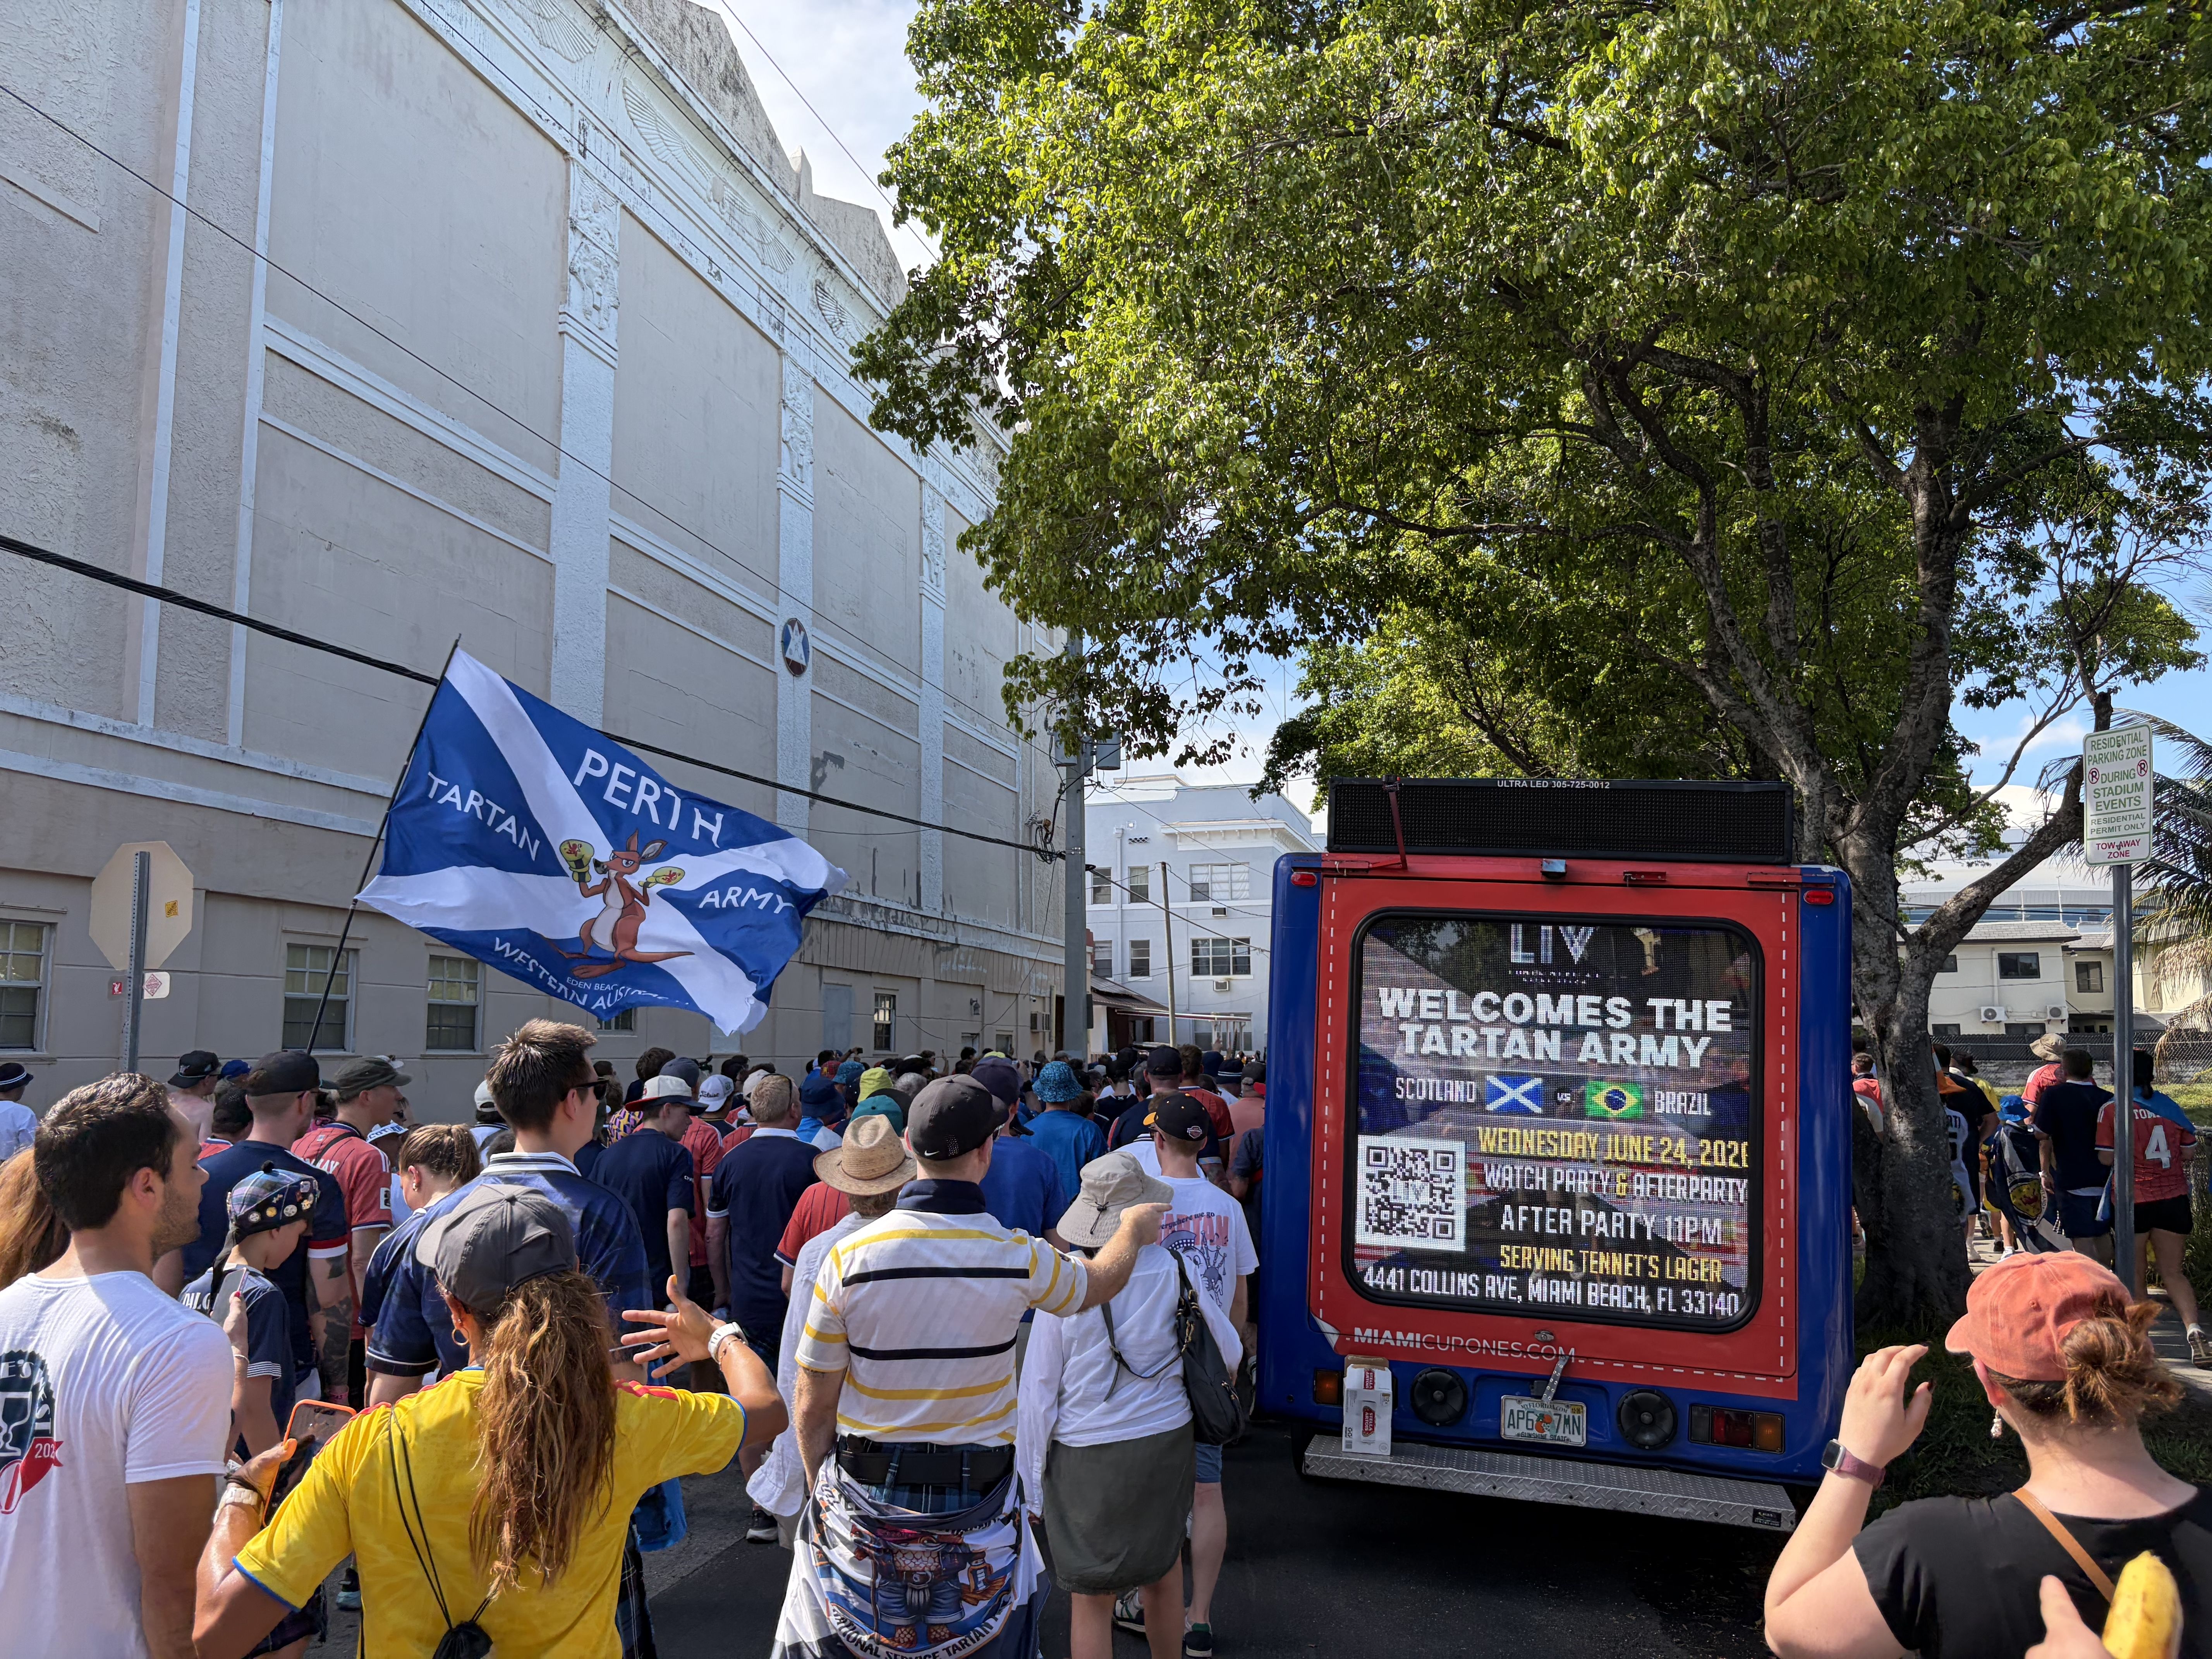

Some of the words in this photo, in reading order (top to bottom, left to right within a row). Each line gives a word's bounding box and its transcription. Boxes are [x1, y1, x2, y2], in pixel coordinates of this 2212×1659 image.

[2088, 749, 2124, 766] PARKING
[2126, 744, 2147, 760] ZONE
[2091, 731, 2143, 751] RESIDENTIAL
[1551, 780, 1610, 789] 305-725-0012
[2093, 781, 2143, 799] STADIUM
[2101, 768, 2136, 784] DURING
[573, 748, 725, 848] PERTH
[2096, 795, 2141, 811] EVENTS
[428, 771, 541, 862] TARTAN
[2090, 825, 2122, 835] PERMIT
[2124, 822, 2146, 831] ONLY
[2091, 812, 2145, 826] RESIDENTIAL
[2107, 850, 2130, 859] ZONE
[698, 885, 796, 914] ARMY
[1511, 923, 1597, 964] LIV
[567, 977, 592, 989] EDEN
[1379, 987, 1632, 1030] WELCOMES
[1647, 998, 1733, 1032] THE
[1398, 1022, 1561, 1062] TARTAN
[1577, 1032, 1711, 1068] ARMY
[1396, 1077, 1477, 1103] SCOTLAND
[1654, 1091, 1712, 1116] BRAZIL
[1477, 1126, 1600, 1159] WEDNESDAY
[1604, 1135, 1653, 1163] JUNE
[1659, 1139, 1692, 1169] 24,
[2145, 1125, 2171, 1169] 4
[1483, 1161, 1546, 1192] WATCH
[1553, 1166, 1611, 1195] PARTY
[1616, 1172, 1628, 1197] &
[1634, 1172, 1748, 1203] AFTERPARTY
[1500, 1204, 1573, 1235] AFTER
[1581, 1209, 1656, 1241] PARTY
[1665, 1213, 1723, 1245] 11PM
[1500, 1244, 1575, 1273] SERVING
[1579, 1249, 1659, 1278] TENNET'S
[1666, 1255, 1722, 1283] LAGER
[1364, 1266, 1405, 1291] 4441
[1410, 1269, 1480, 1297] COLLINS
[1485, 1274, 1522, 1304] AVE,
[1528, 1277, 1582, 1307] MIAMI
[1587, 1281, 1652, 1314] BEACH,
[1657, 1286, 1677, 1313] FL
[1681, 1289, 1740, 1317] 33140
[1354, 1327, 1575, 1363] MIAMICUPONES.COM
[1507, 1409, 1534, 1431] AP6
[1553, 1413, 1581, 1435] 7MN
